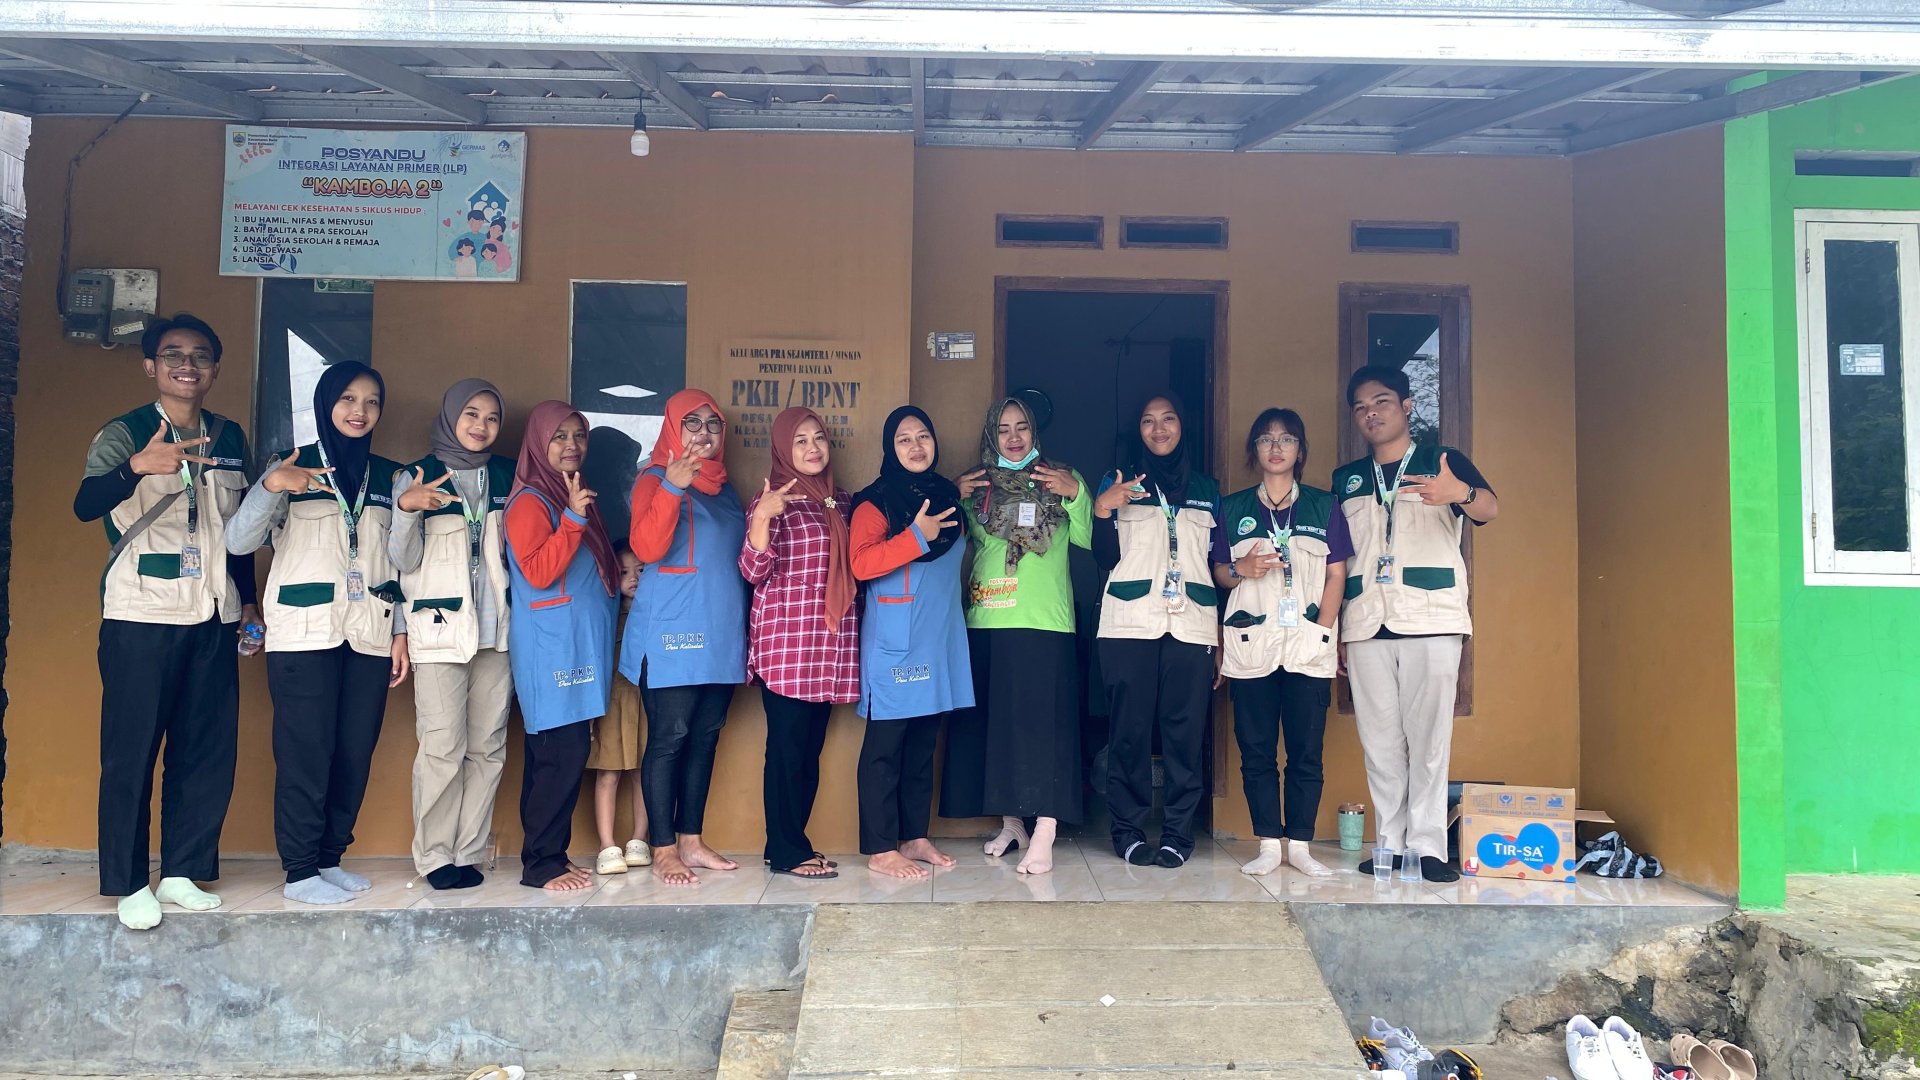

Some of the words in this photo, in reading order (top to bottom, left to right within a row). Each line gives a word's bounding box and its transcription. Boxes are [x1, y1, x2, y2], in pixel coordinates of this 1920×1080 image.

[321, 147, 426, 162] POSYANDU
[278, 160, 338, 171] INTEGRASI
[341, 162, 394, 172] LAYANAN
[397, 163, 440, 173] PRIMER
[443, 164, 467, 175] (ILP)
[234, 203, 279, 211] MELAYANI
[300, 205, 353, 213] KESEHATAN
[259, 217, 289, 225] HAMIL,
[291, 217, 317, 225] NIFAS
[328, 218, 373, 226] MENYUSUI
[730, 348, 768, 358] KELUARGA
[770, 349, 785, 359] PRA
[835, 350, 861, 360] MISKIN
[759, 363, 796, 374] PENERIMA
[799, 364, 832, 374] BANTUAN
[731, 380, 779, 407] PKH
[786, 379, 795, 409] /
[802, 381, 860, 408] BPNT
[741, 413, 773, 424] DESA
[1492, 842, 1543, 857] TIR-SA
